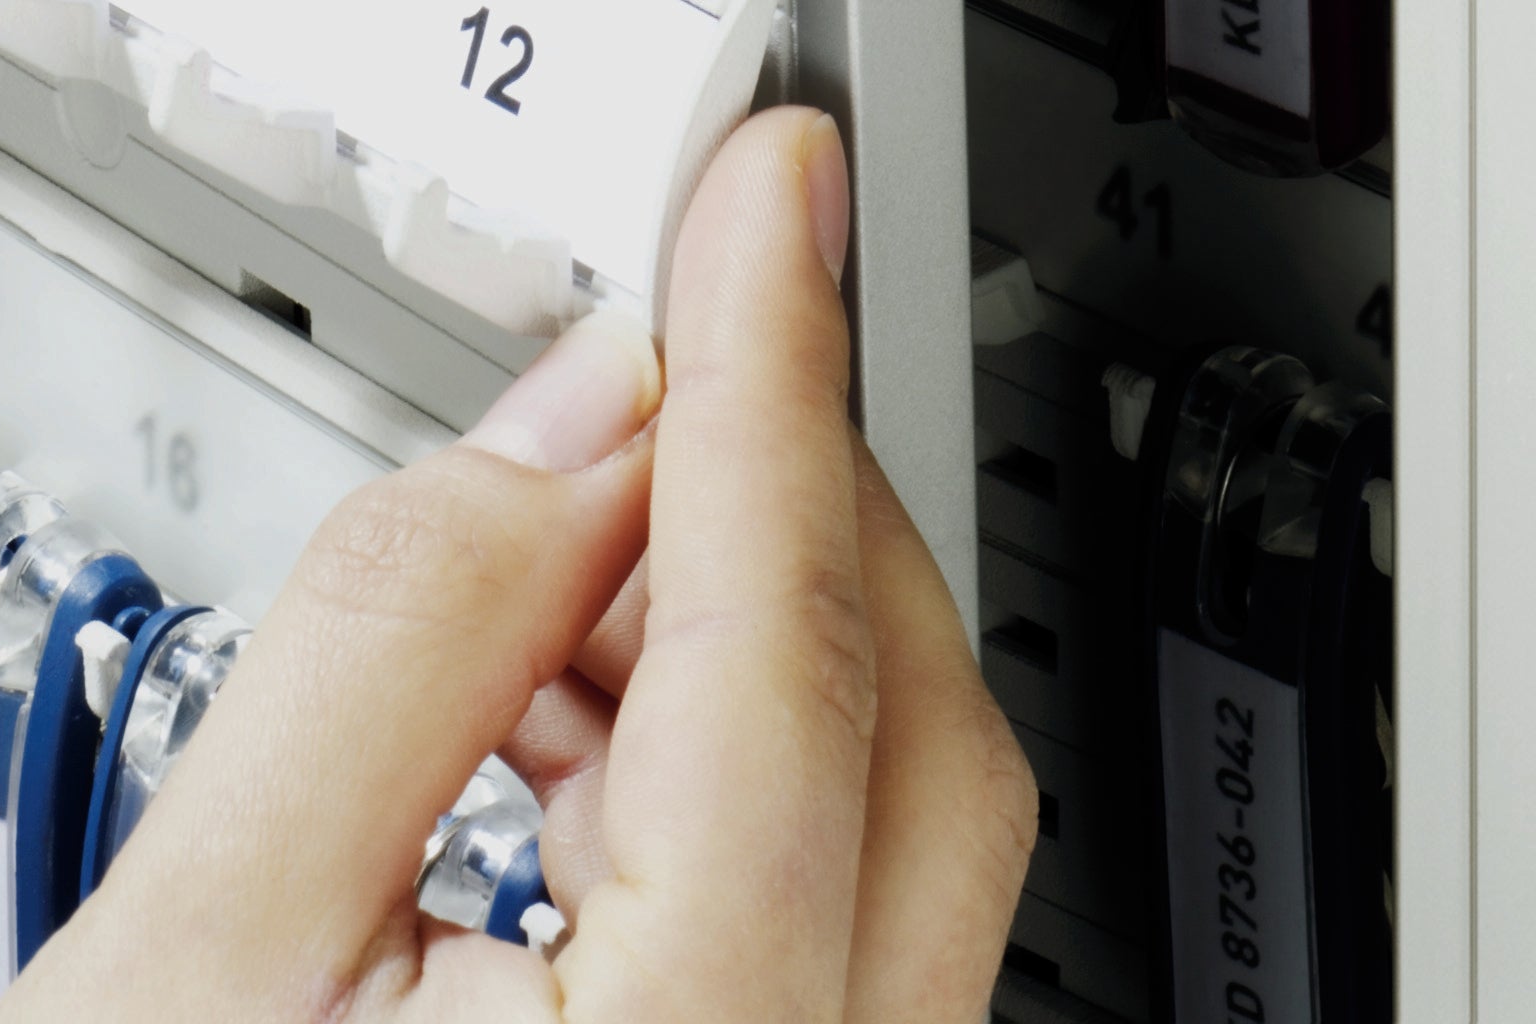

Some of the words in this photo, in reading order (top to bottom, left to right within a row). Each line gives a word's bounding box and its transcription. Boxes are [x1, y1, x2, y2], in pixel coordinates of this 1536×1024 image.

[461, 7, 533, 115] 12
[1097, 162, 1173, 260] 41
[1355, 283, 1391, 360] 4
[135, 416, 200, 513] 16
[1215, 697, 1260, 969] 8736-042
[1225, 981, 1265, 1024] D
